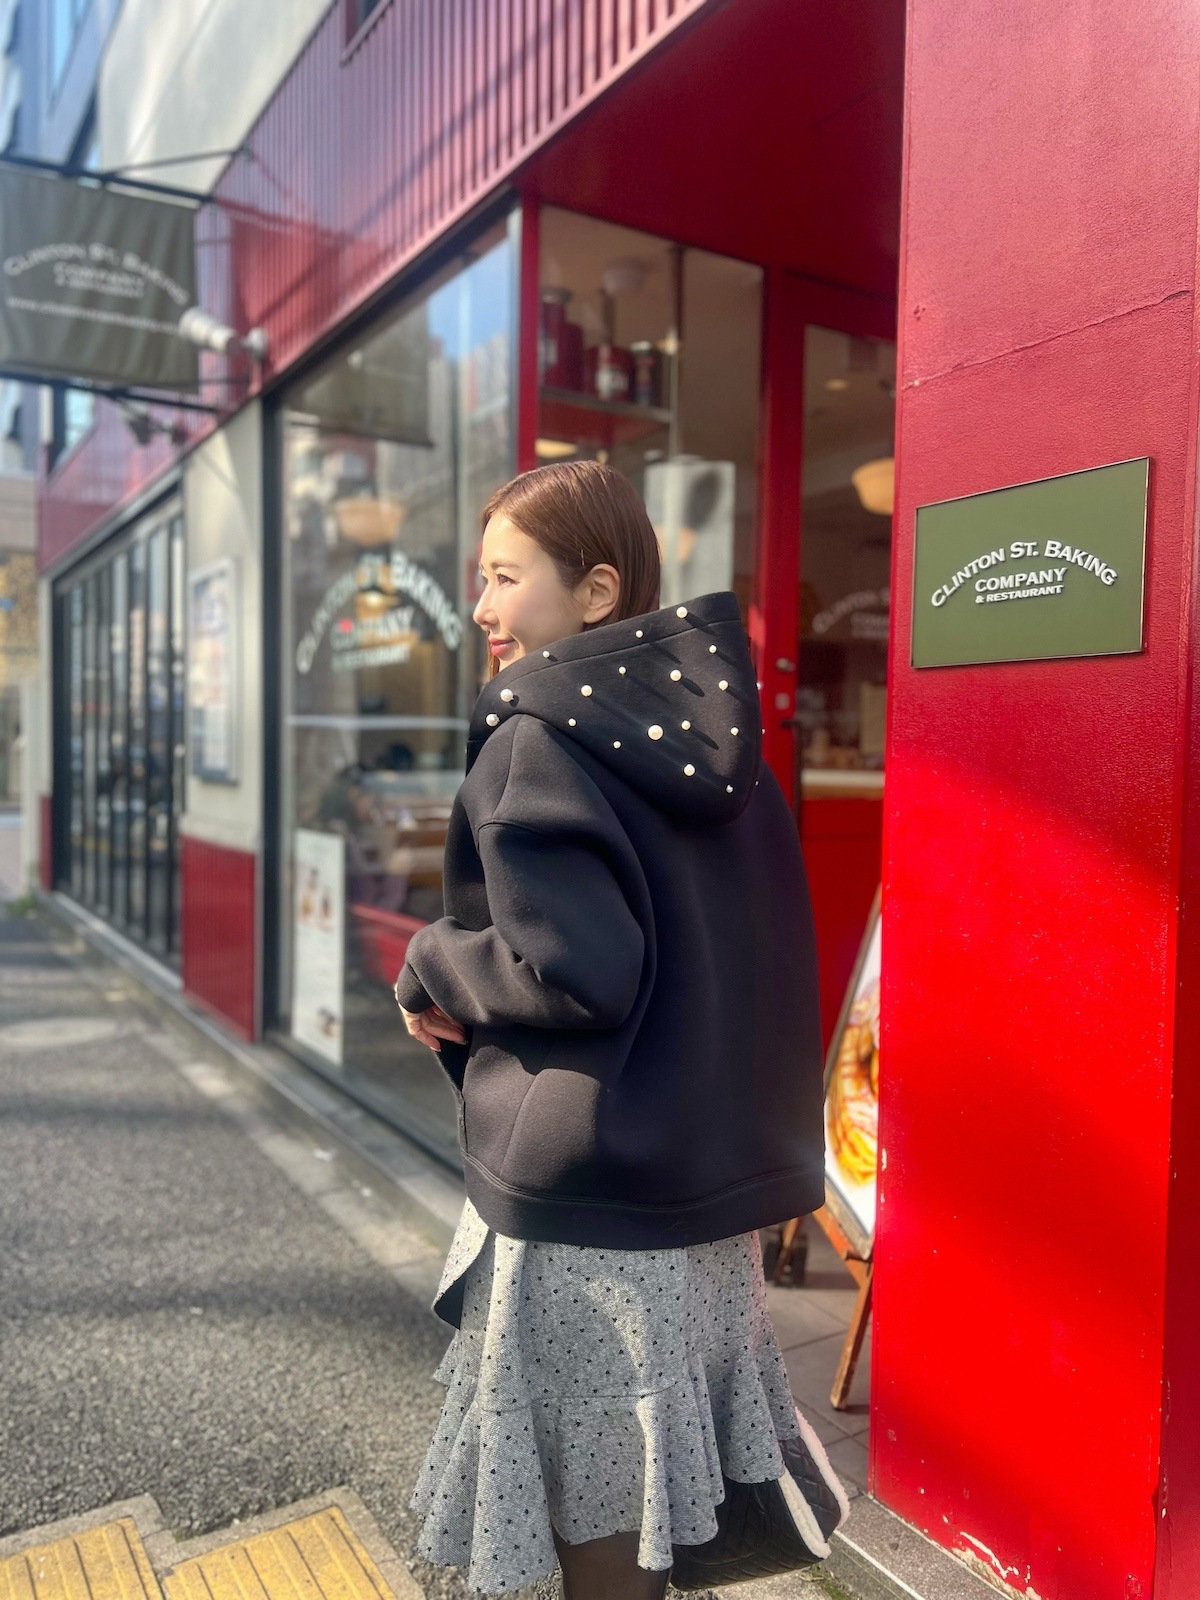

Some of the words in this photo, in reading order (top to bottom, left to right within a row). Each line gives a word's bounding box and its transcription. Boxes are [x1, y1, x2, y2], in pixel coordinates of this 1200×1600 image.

[931, 548, 1006, 607] CLINTON
[1010, 541, 1039, 559] ST.
[1044, 540, 1118, 586] BAKING
[975, 567, 1067, 593] COMPANY
[975, 595, 985, 604] &
[986, 585, 1064, 602] RESTAURANT
[391, 551, 463, 650] BAKING
